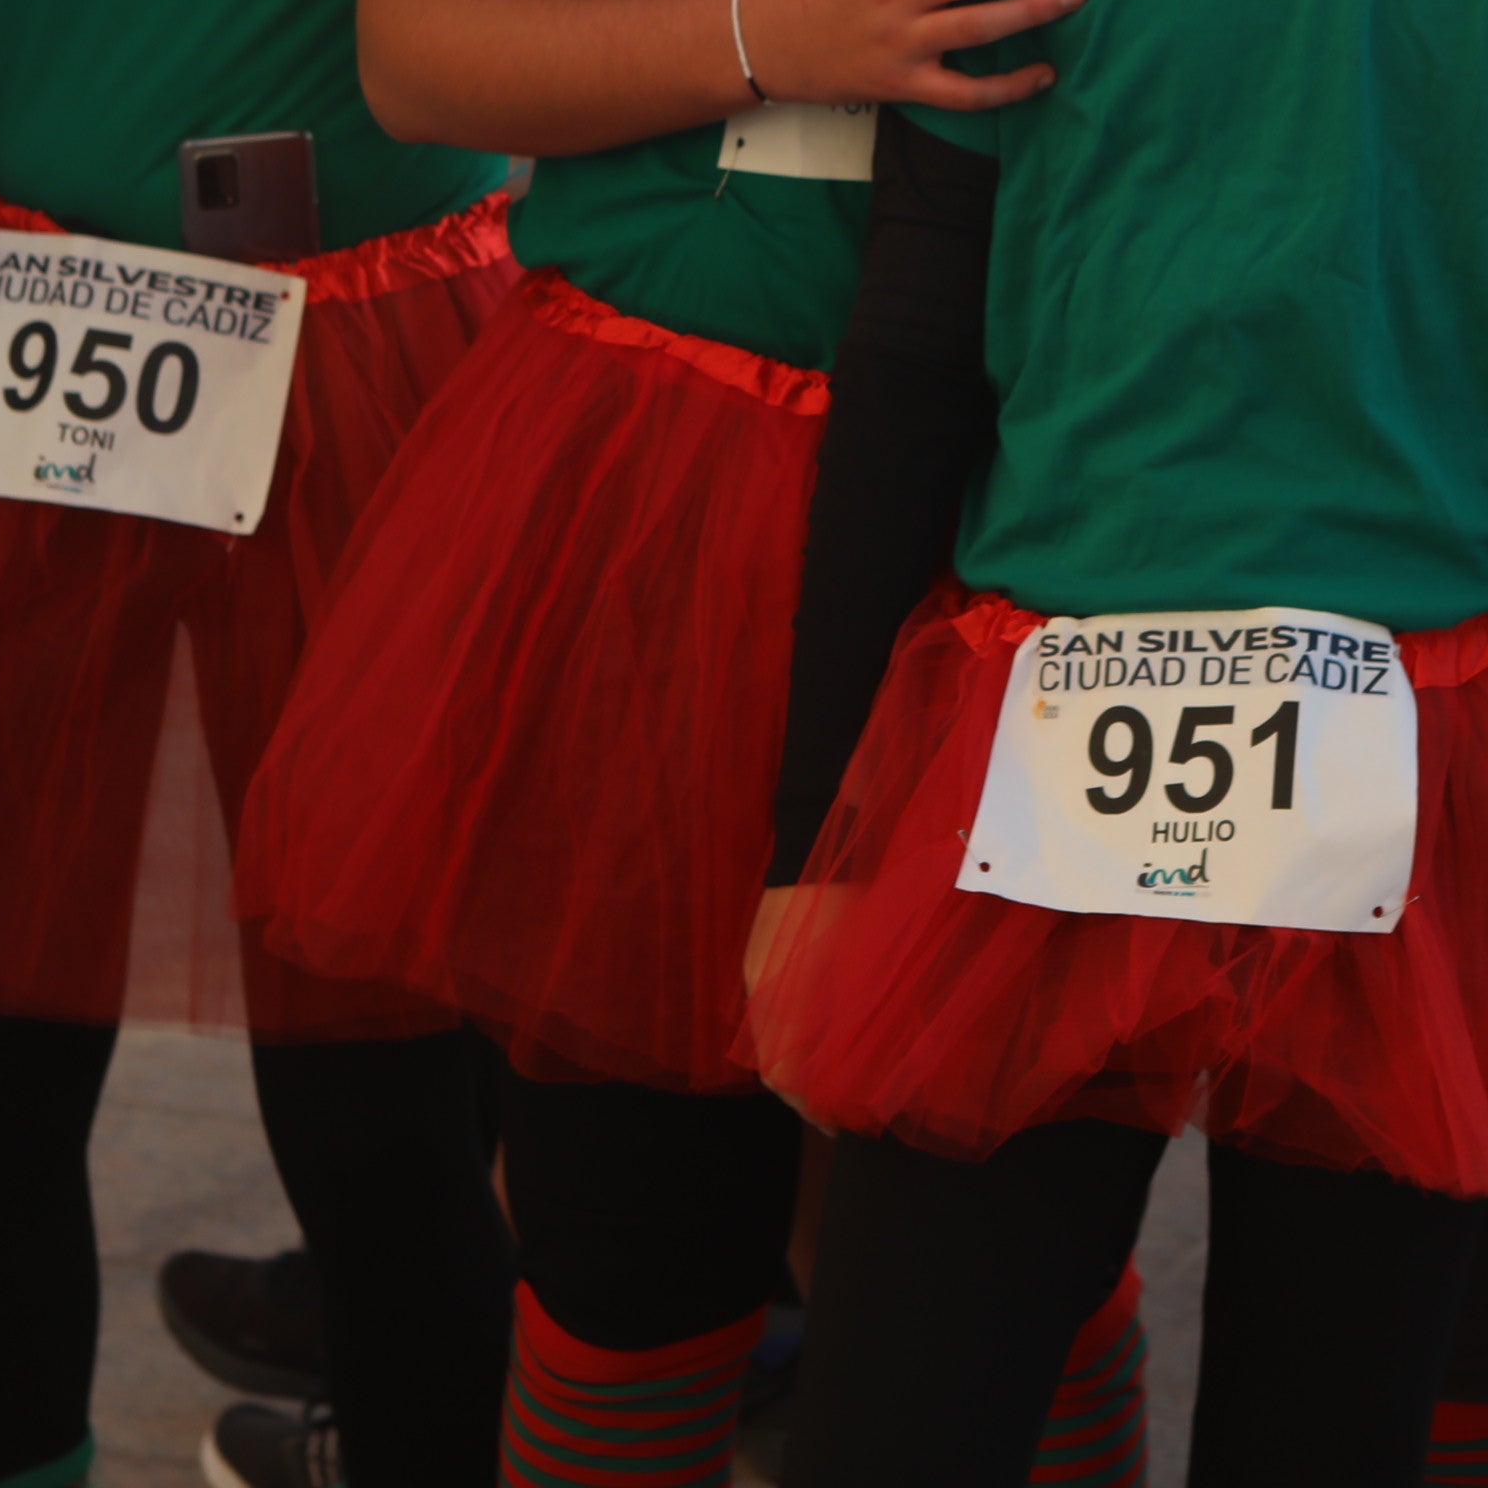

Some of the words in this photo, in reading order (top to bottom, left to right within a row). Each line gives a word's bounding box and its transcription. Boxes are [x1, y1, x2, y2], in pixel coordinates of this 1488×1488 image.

[59, 256, 282, 314] SILVESTRE
[105, 287, 151, 320] DE
[2, 320, 200, 436] 950
[57, 424, 116, 451] TONI
[1038, 630, 1123, 658] SAN
[1137, 626, 1391, 664] SILVESTRE
[1038, 657, 1185, 692] CIUDAD
[1200, 656, 1251, 687] DE
[1085, 700, 1300, 815] 951
[1151, 819, 1236, 843] HULIO
[1137, 848, 1210, 889] imd
